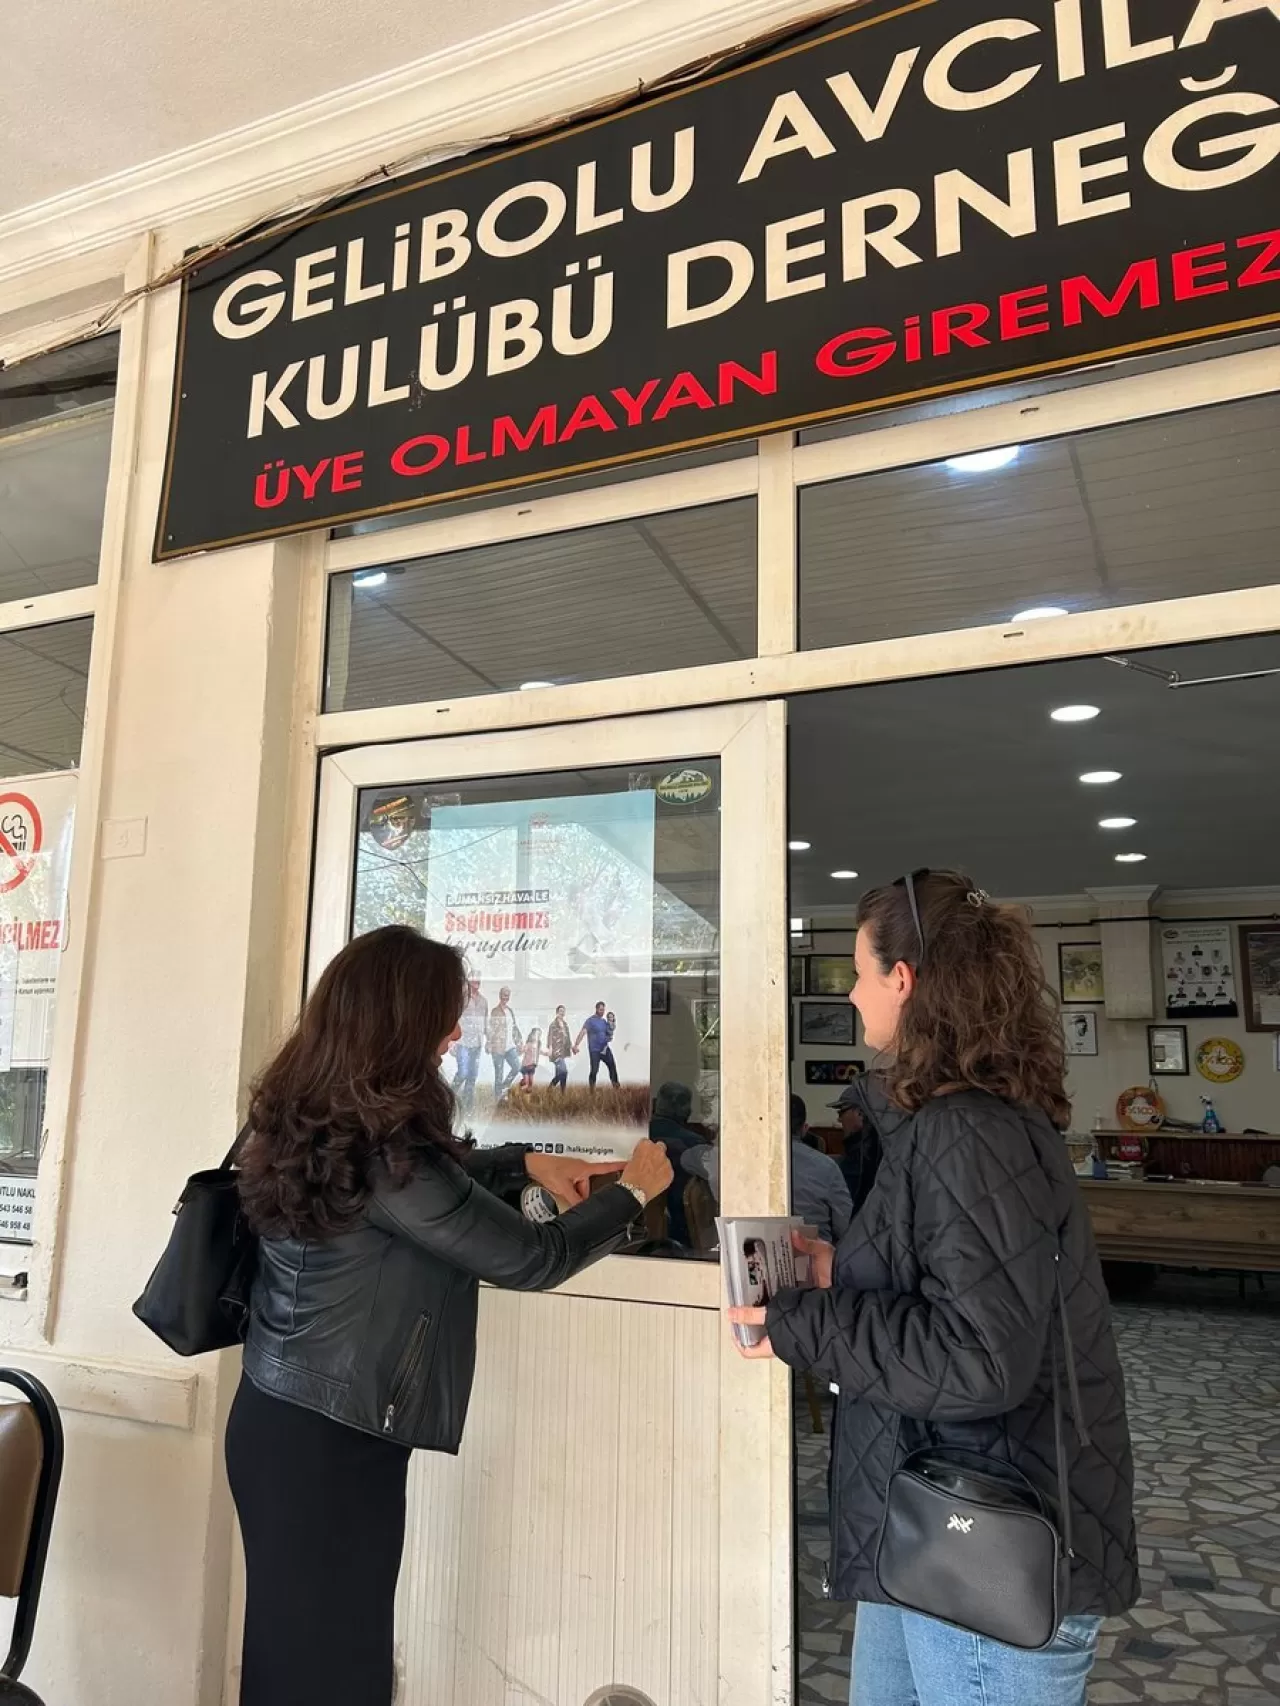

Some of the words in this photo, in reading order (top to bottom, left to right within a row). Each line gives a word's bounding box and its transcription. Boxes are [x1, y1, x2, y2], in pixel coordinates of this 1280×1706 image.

[246, 255, 615, 439] KULÜBÜ
[666, 65, 1280, 329] DERNEĞ
[253, 450, 364, 508] ÜYE
[390, 350, 778, 476] OLMAYAN
